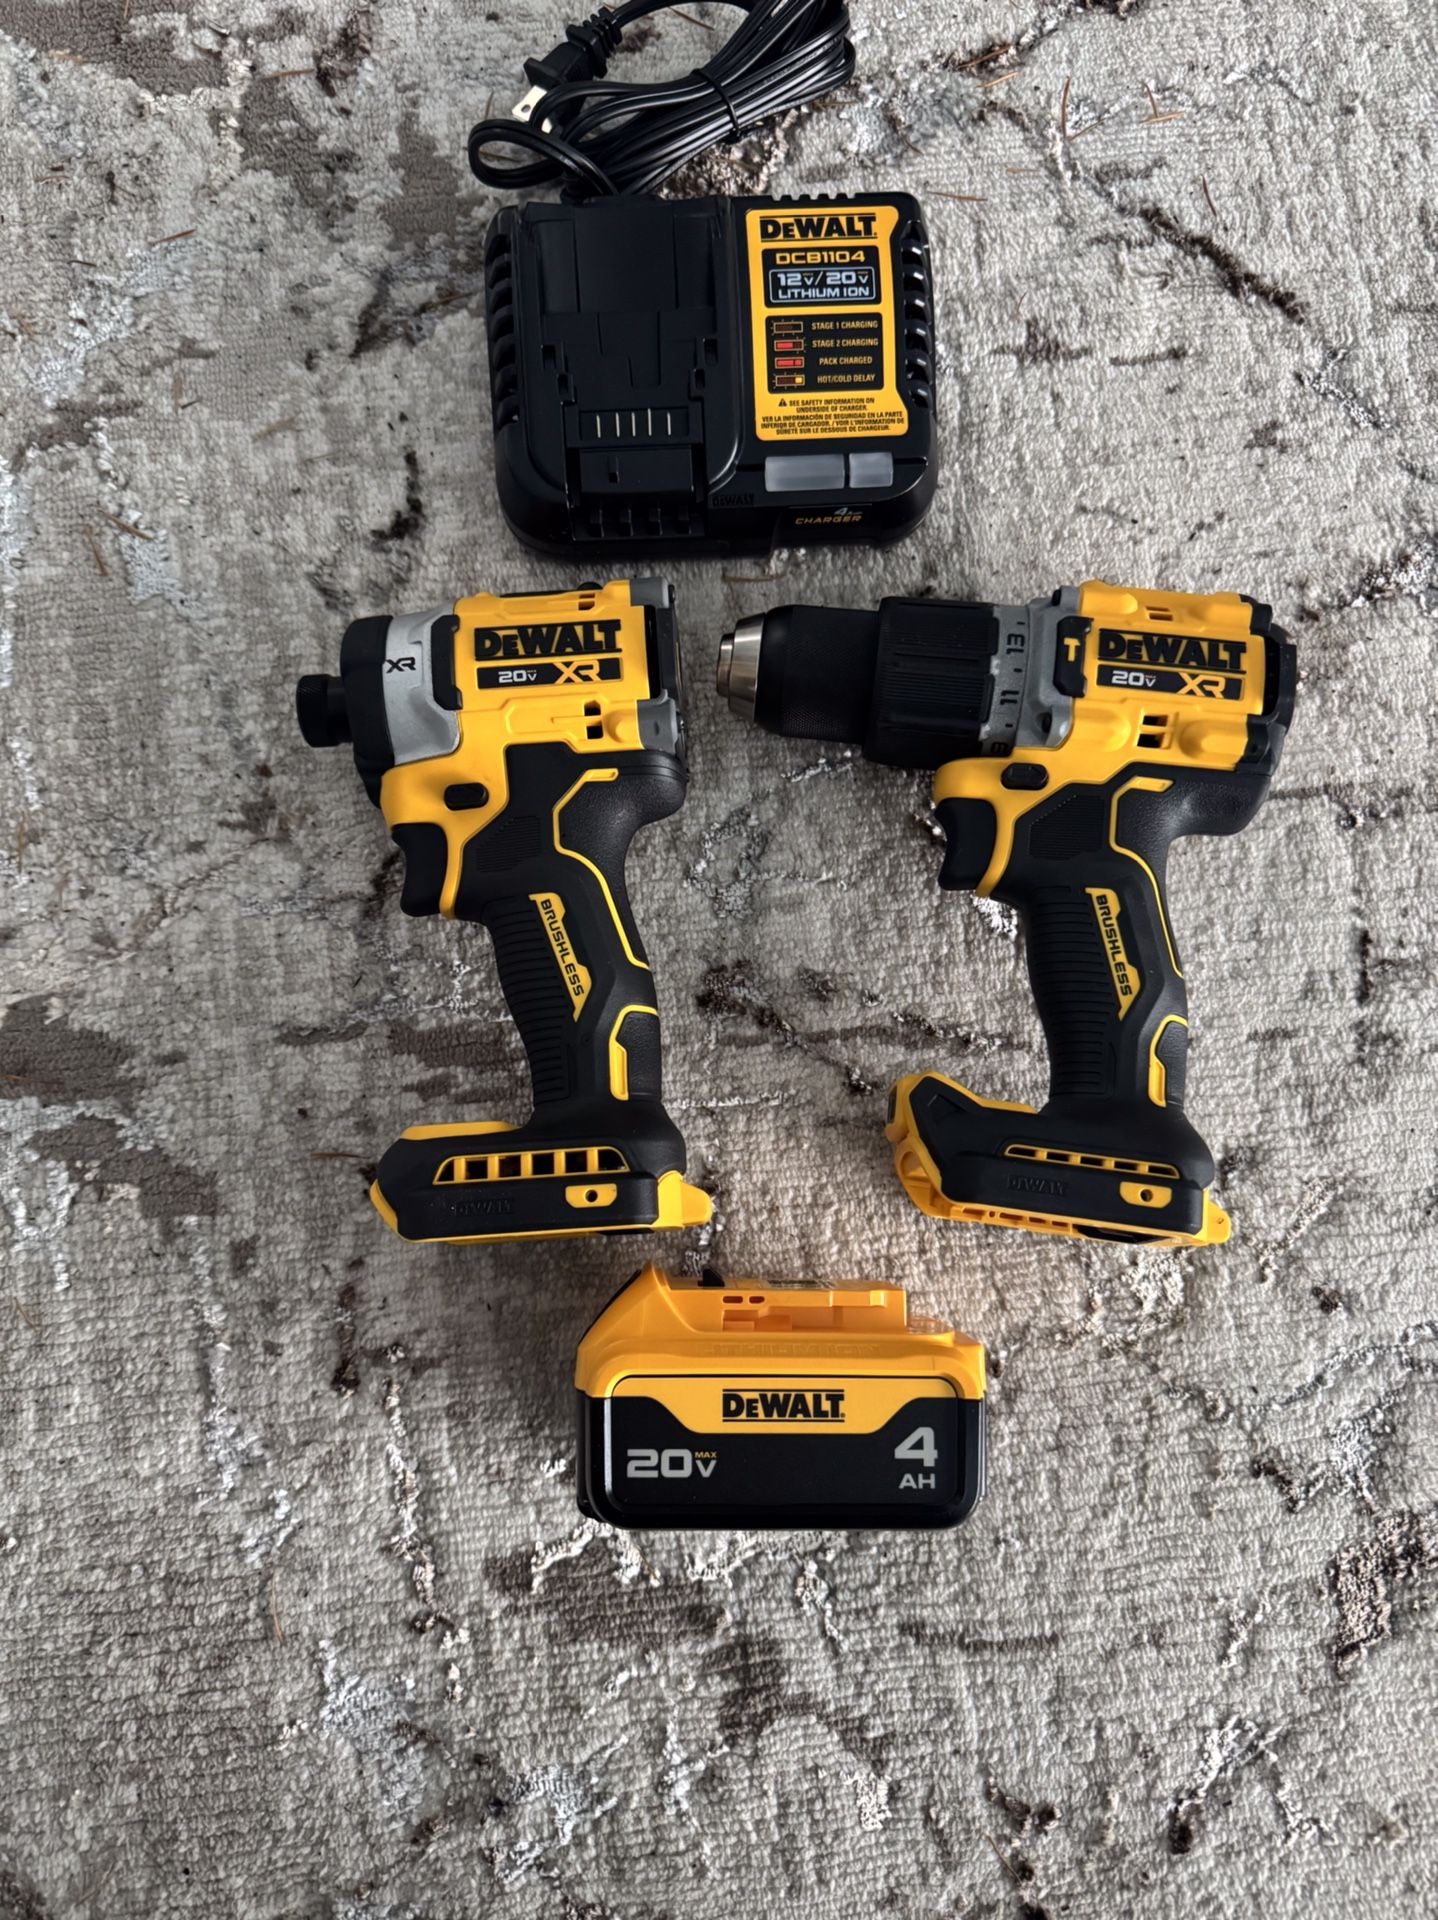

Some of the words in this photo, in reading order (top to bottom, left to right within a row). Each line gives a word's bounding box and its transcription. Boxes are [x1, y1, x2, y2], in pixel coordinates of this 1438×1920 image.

[775, 250, 866, 265] DCB1104
[778, 287, 840, 299] LITHIUM
[843, 286, 870, 297] ION
[811, 321, 834, 330] STAGE
[841, 320, 878, 330] CHARGING
[811, 339, 834, 348] STAGE
[841, 338, 879, 347] CHARGING
[819, 357, 838, 366] PACK
[839, 356, 873, 365] CHARGED
[817, 375, 852, 384] HOT/COLD
[853, 374, 875, 382] DELAY
[789, 399, 800, 407] SEE
[801, 398, 822, 406] SAFETY
[833, 412, 866, 420] SEGURIDAD
[795, 515, 862, 525] CHARGER
[386, 656, 416, 674] XR
[553, 660, 601, 684] XR
[1177, 672, 1226, 698] XR
[541, 898, 584, 997] BRUSHLESS
[1096, 894, 1132, 996] BRUSHLESS
[894, 1426, 937, 1467] 4
[695, 1451, 717, 1459] MAX
[899, 1473, 936, 1489] AH
